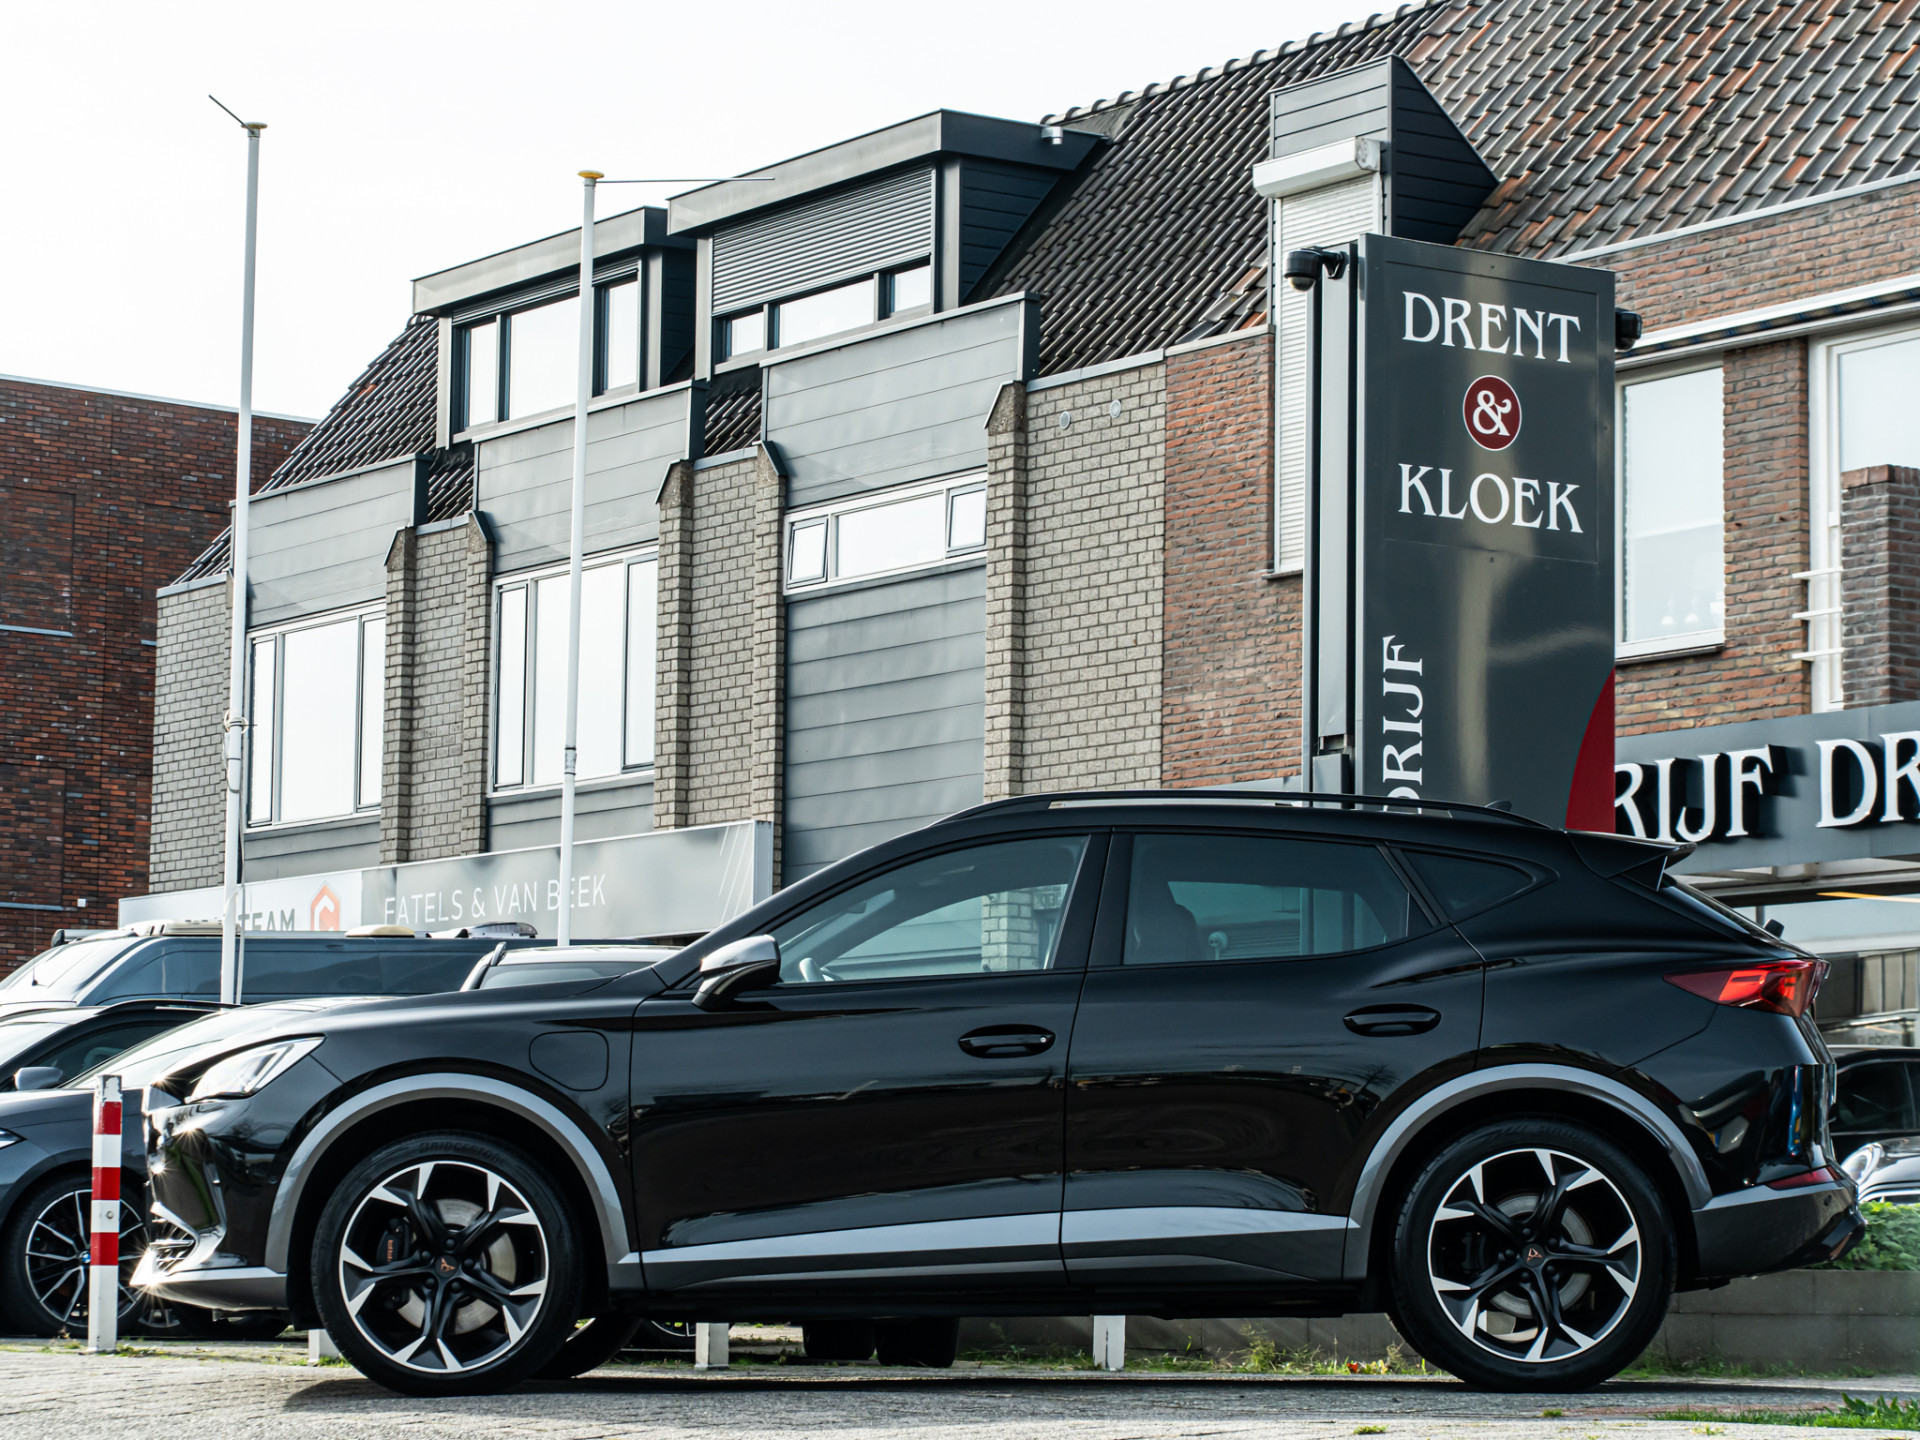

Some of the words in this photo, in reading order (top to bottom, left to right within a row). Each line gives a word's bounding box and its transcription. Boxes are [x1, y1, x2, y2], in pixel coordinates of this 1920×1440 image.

[1402, 291, 1581, 363] DRENT
[1472, 390, 1511, 437] &
[1398, 463, 1584, 533] KLOEK
[471, 887, 486, 919] &
[494, 881, 537, 915] VAN
